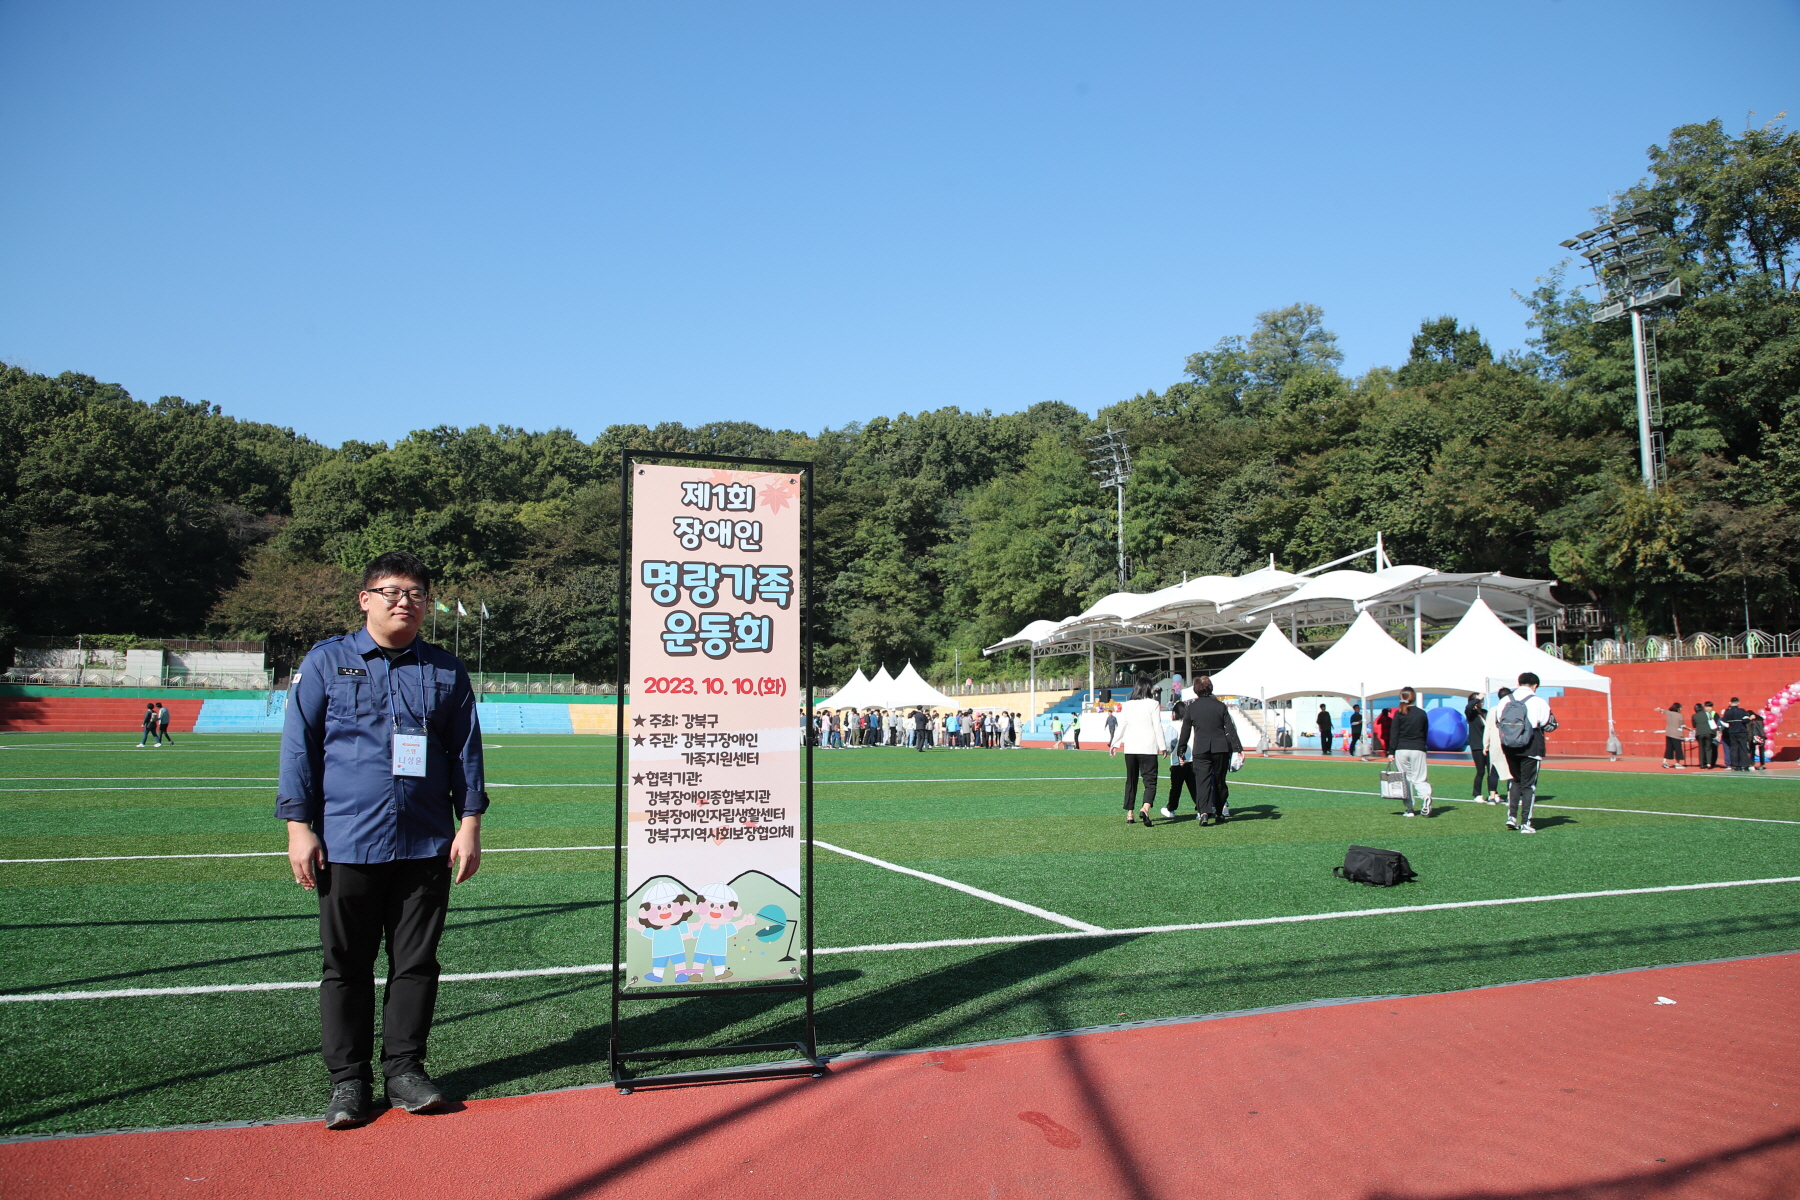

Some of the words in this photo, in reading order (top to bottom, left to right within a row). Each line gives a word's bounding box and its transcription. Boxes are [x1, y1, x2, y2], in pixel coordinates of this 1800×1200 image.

[681, 481, 755, 512] 제1회
[673, 516, 762, 552] 장애인
[641, 560, 794, 610] 명랑가족
[660, 610, 773, 660] 운동회
[643, 677, 698, 695] 2023.
[702, 677, 728, 695] 10.
[649, 714, 679, 728] 주최:
[682, 714, 719, 729] 강북구
[649, 733, 679, 748] 주관:
[681, 733, 758, 748] 강북구장애인
[681, 752, 760, 767] 가족지원센터
[645, 771, 703, 787] 협력기관:
[645, 789, 771, 806] 강북장애인종합복지관
[645, 807, 786, 825] 강북장애인자립생활센터
[645, 825, 794, 844] 강북구지역사회보장협의체
